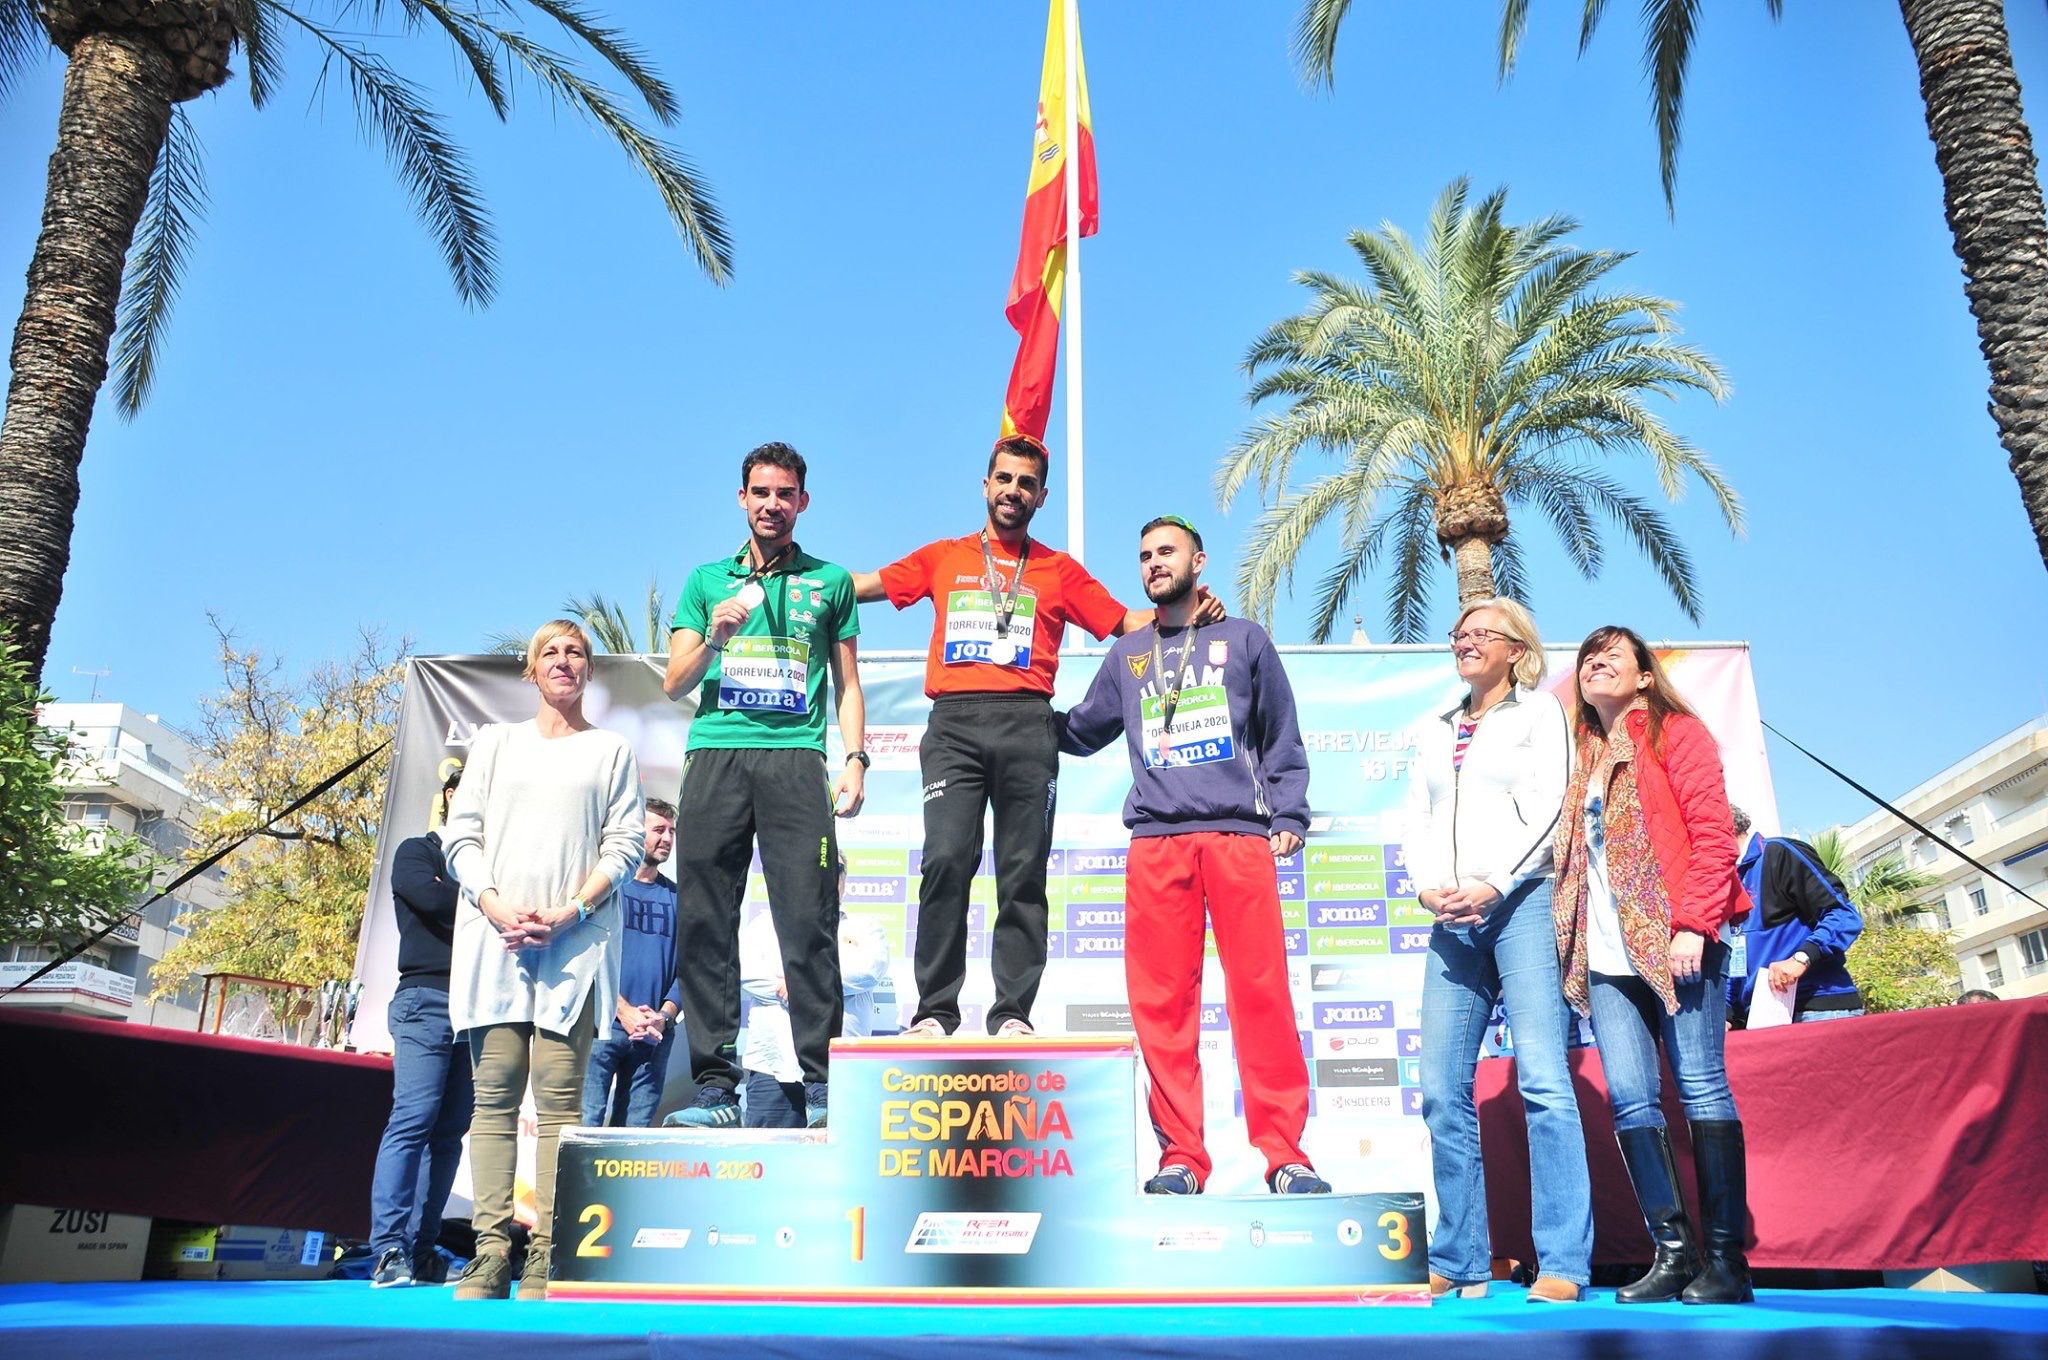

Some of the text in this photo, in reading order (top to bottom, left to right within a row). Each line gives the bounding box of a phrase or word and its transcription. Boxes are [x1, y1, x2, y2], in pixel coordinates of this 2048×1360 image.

[1008, 625, 1031, 636] 2020
[752, 642, 801, 656] IBERDROLA
[724, 667, 805, 682] TORREVIEJA 2020
[1204, 715, 1228, 728] 2020
[1329, 854, 1376, 863] IBERDROLA
[1332, 883, 1380, 891] IBERDROLA
[1335, 938, 1383, 947] IBERDROLA
[882, 1067, 1067, 1097] Campeonato de
[880, 1095, 1074, 1141] ESPAÑA
[594, 1159, 764, 1180] TORREVIEJA 2020
[879, 1147, 1074, 1178] DE MARCHA
[576, 1204, 614, 1259] 2
[845, 1205, 865, 1262] 1
[1377, 1211, 1413, 1261] 3
